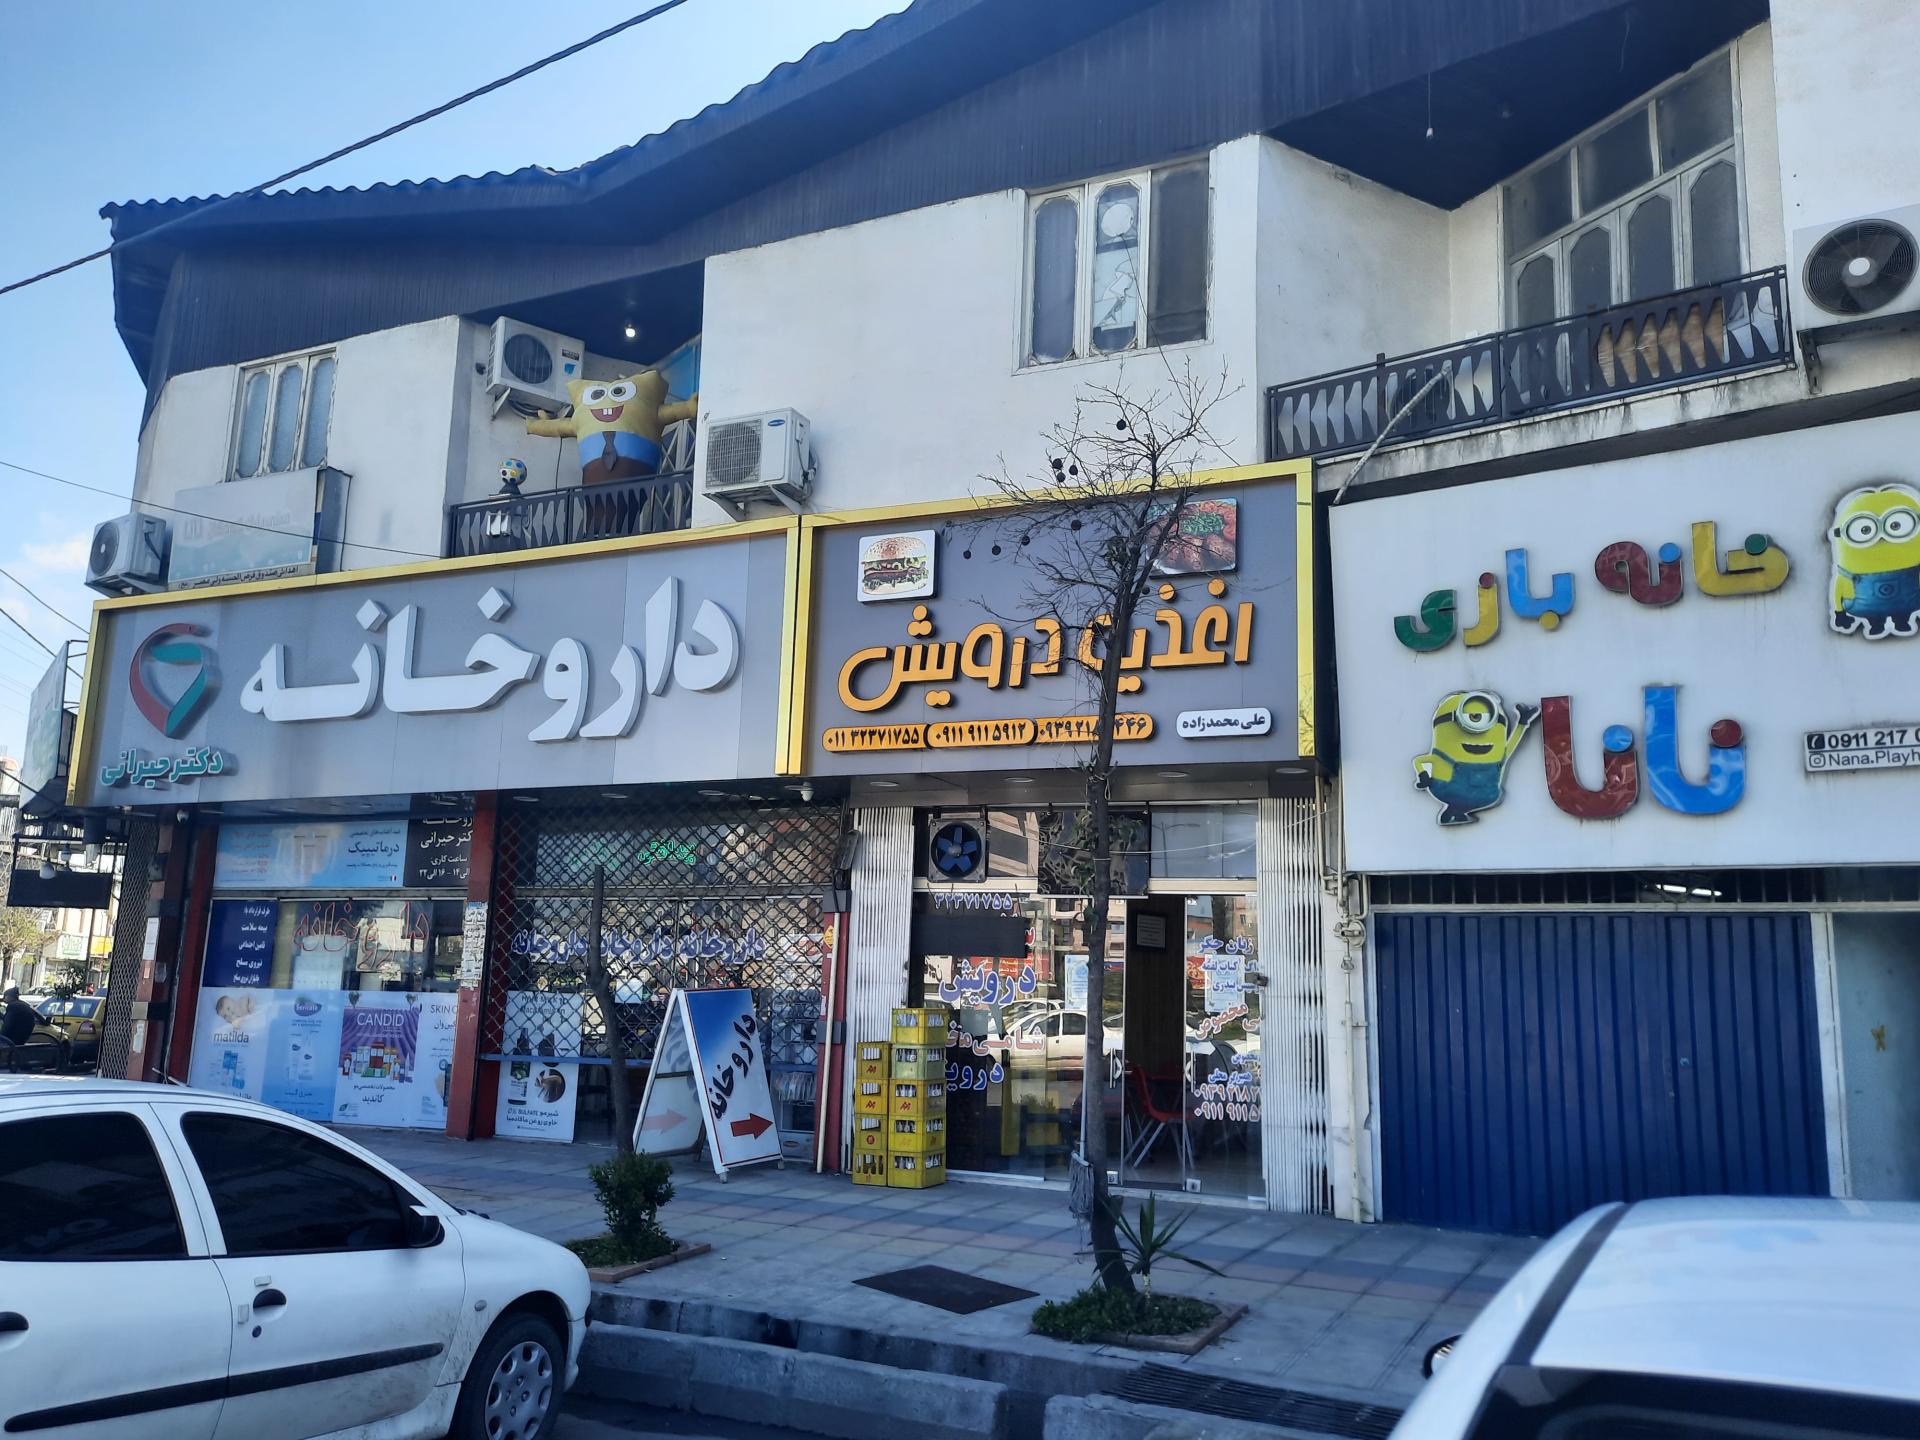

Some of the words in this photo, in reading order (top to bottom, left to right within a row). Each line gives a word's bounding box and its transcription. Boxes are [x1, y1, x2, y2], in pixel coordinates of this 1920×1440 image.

[1594, 520, 1790, 608] خانه
[1394, 548, 1576, 652] بازی
[240, 575, 740, 742] داروخانه
[837, 604, 1064, 712] درویش
[935, 726, 964, 744] ۰۹۱۱
[967, 724, 988, 742] ۹۱۱
[992, 722, 1026, 741] ۵۹۱۲
[1182, 716, 1240, 732] محمدزاده
[1240, 713, 1266, 730] علی
[827, 734, 846, 748] ۰۱۱
[850, 730, 919, 747] ۳۲۳۷۱۷۵۵
[1540, 685, 1747, 819] نانا
[1828, 732, 1868, 749] 0911
[1874, 729, 1908, 746] 217
[101, 748, 171, 789] حیرانی
[168, 746, 224, 783] دکتر
[293, 901, 430, 972] داروخانه
[938, 958, 1037, 1005] درویش
[356, 1013, 405, 1027] CANDID
[430, 1004, 451, 1014] SKIN
[213, 1032, 249, 1043] matilda
[972, 1025, 1045, 1057] شامی
[710, 1014, 756, 1120] داروخانه
[945, 1062, 1005, 1092] دروی
[1194, 1083, 1226, 1101] ۰۹۳۹
[1194, 1101, 1224, 1120] ۰۹۱۱
[1226, 1102, 1248, 1122] ۹۱۱
